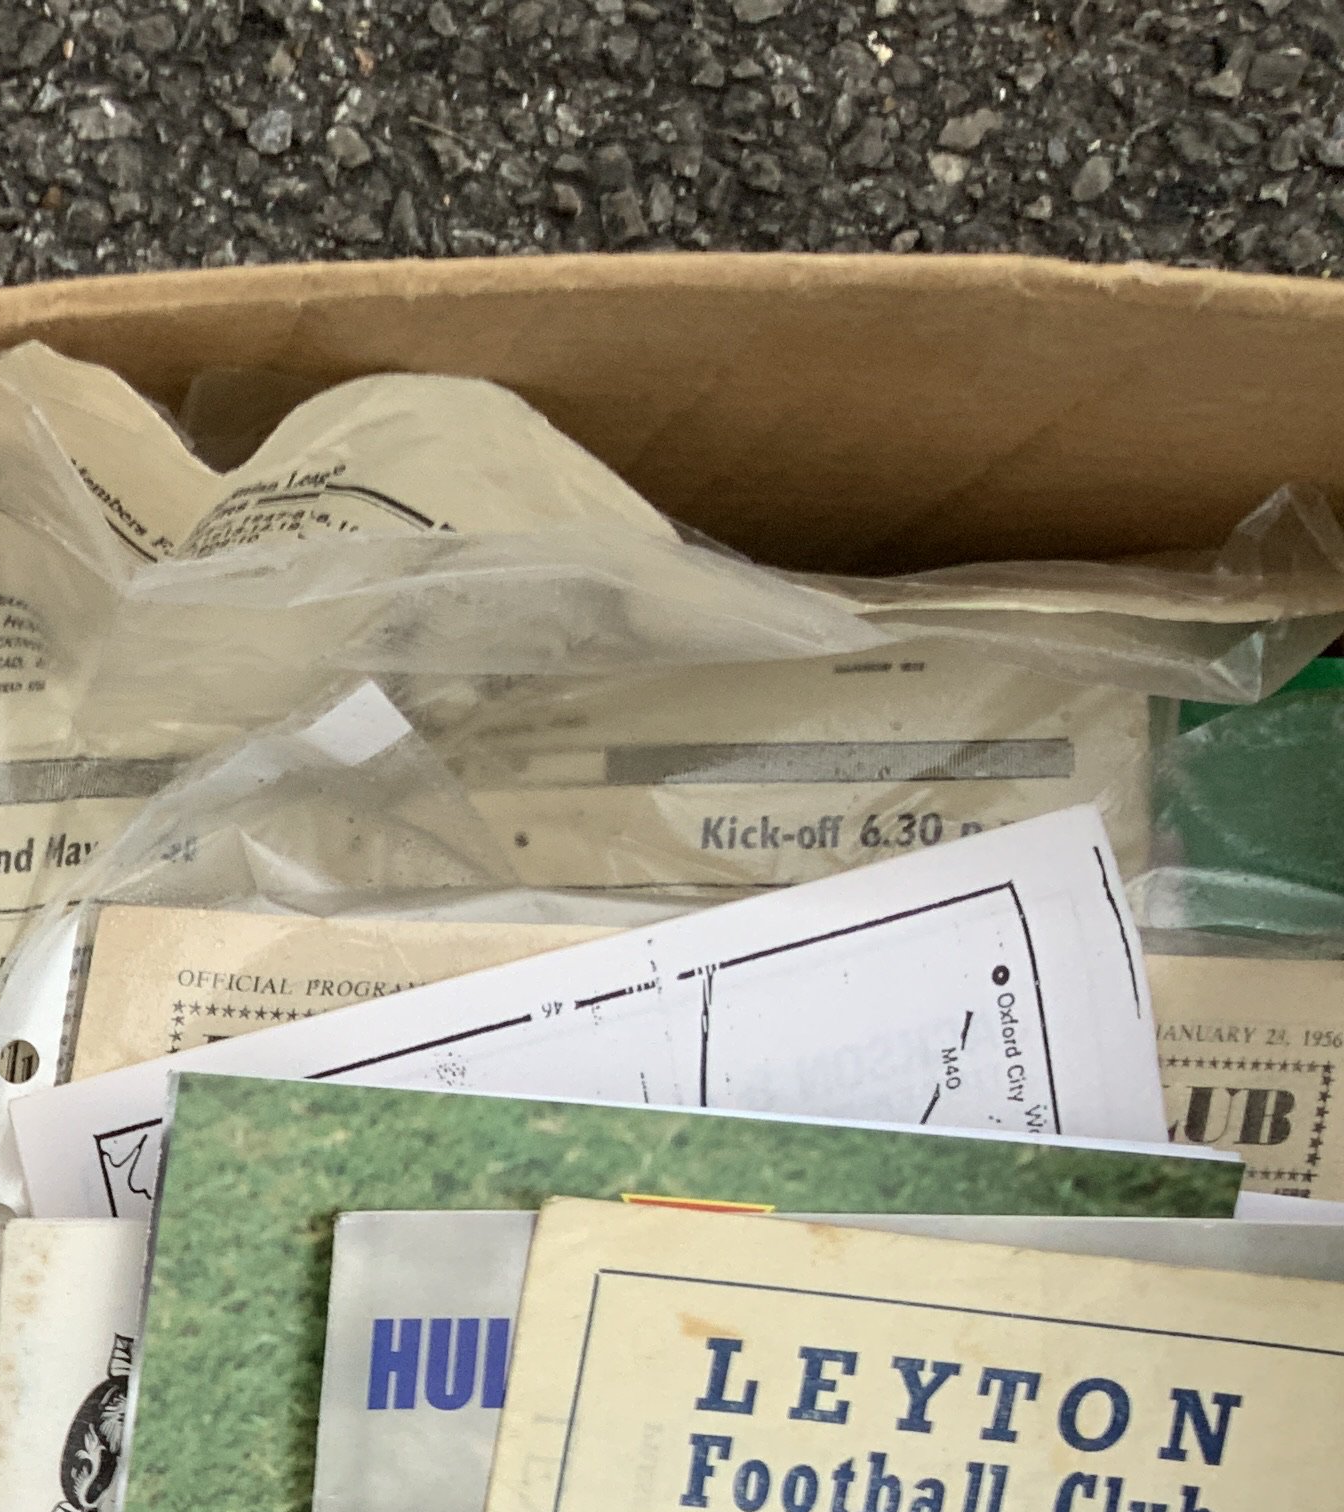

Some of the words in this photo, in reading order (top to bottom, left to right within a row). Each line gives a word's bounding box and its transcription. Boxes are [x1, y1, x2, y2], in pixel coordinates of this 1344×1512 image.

[700, 814, 842, 849] Kick-off
[859, 812, 944, 848] 6.30
[177, 969, 293, 996] OFFICIAL
[997, 992, 1022, 1062] Oxford
[1303, 1030, 1343, 1049] 1956
[942, 1047, 961, 1091] M40
[1006, 1065, 1026, 1104] City
[1168, 1085, 1297, 1147] UB
[695, 1338, 1244, 1468] LEYTON
